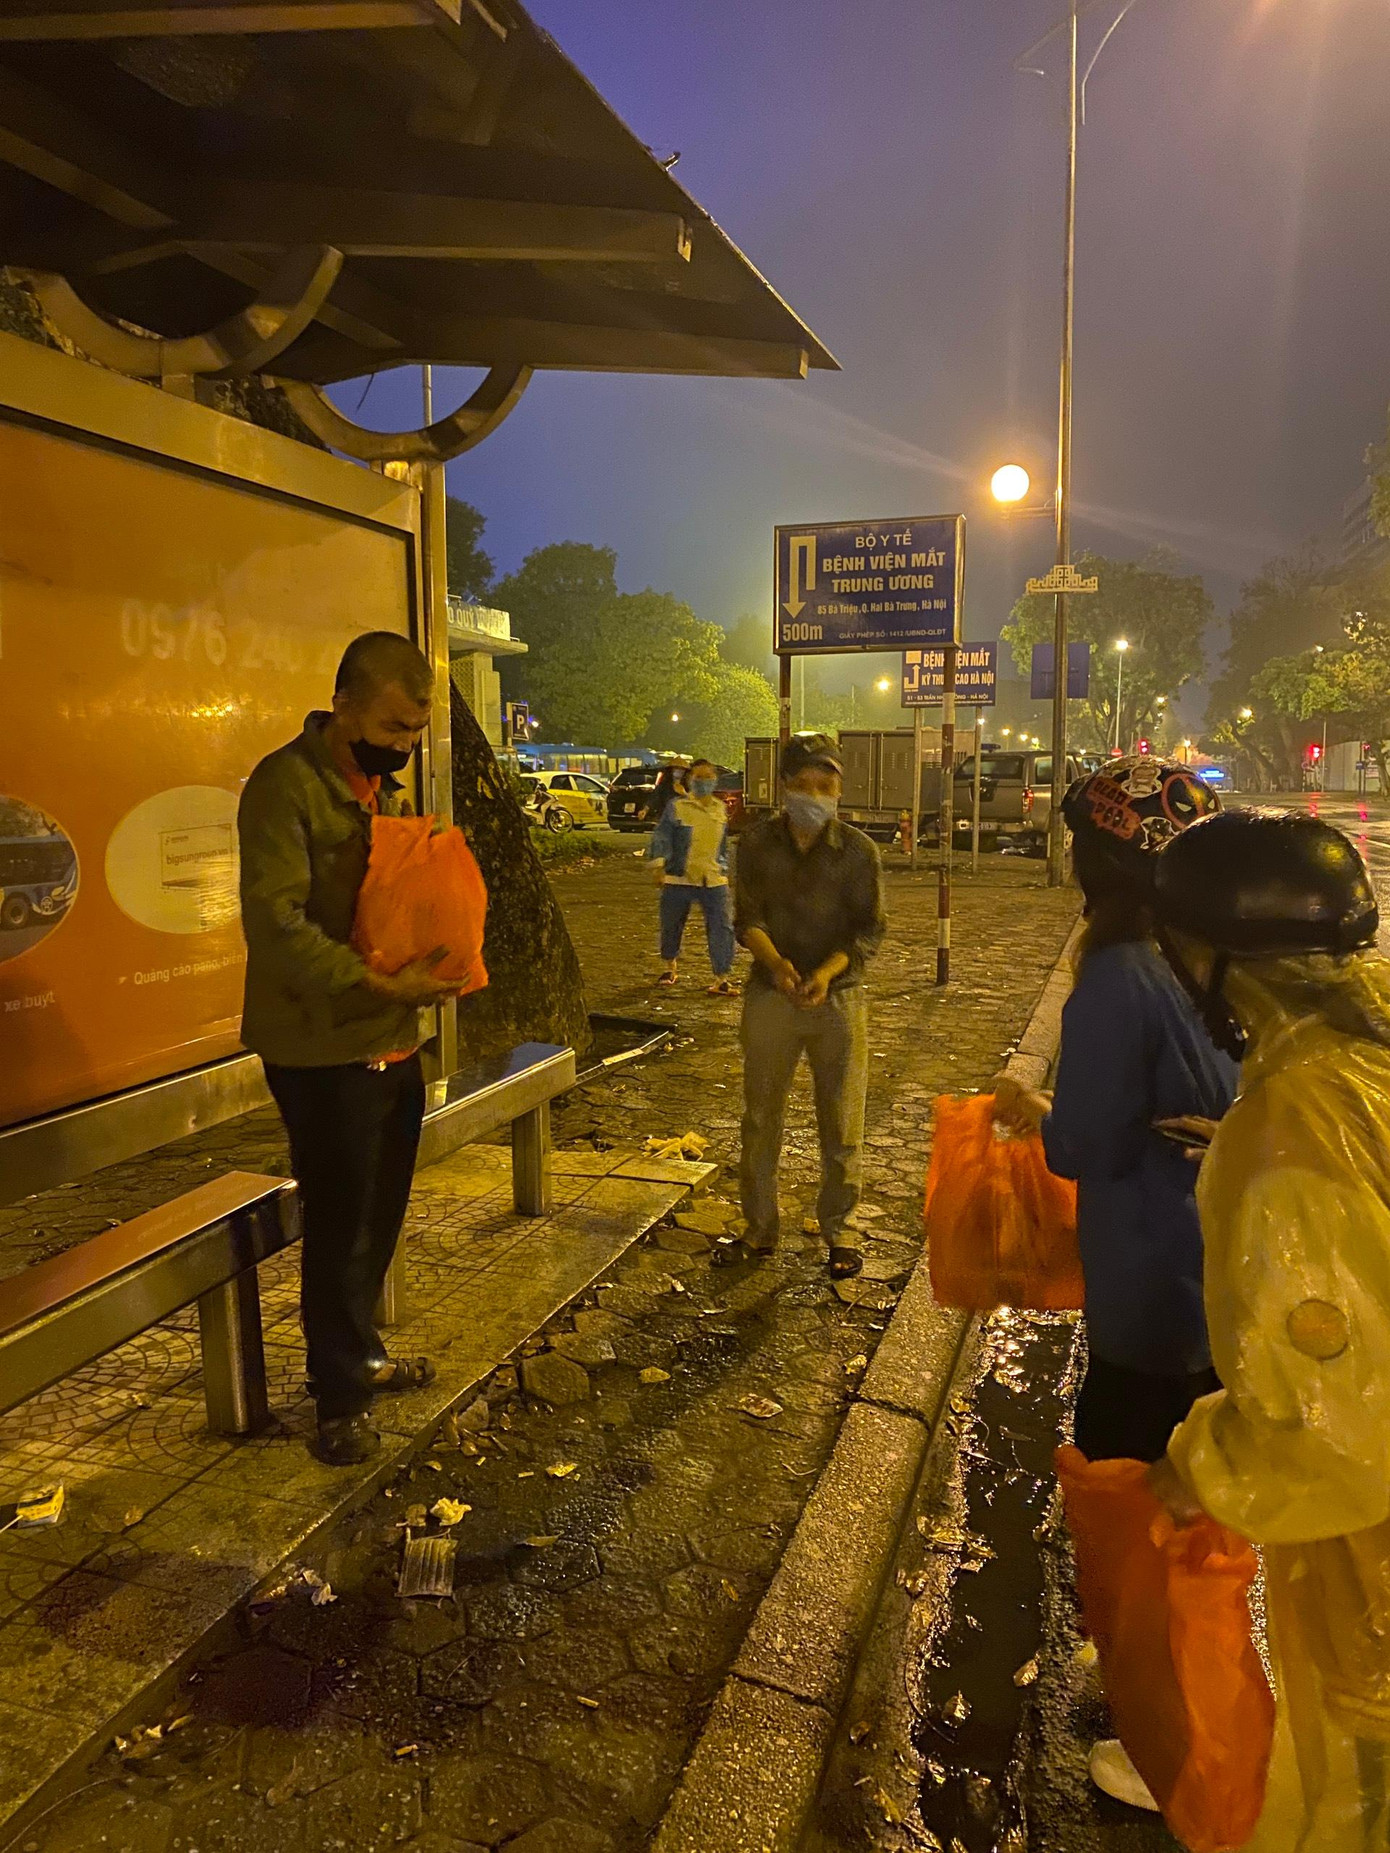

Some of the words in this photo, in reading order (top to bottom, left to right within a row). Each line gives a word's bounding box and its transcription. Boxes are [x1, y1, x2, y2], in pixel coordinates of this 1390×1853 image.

[855, 533, 876, 551] BỘ
[880, 535, 890, 547] Y
[894, 528, 912, 546] TẾ
[822, 555, 865, 574] BỆNH
[869, 552, 906, 571] VIỆN
[911, 547, 946, 567] MẮT
[831, 579, 884, 593] TRUNG
[888, 574, 934, 591] ƯƠNG
[921, 599, 932, 610] Hà
[782, 622, 823, 642] 500m
[970, 647, 990, 667] MẮT
[954, 672, 969, 685] CAO
[970, 670, 980, 685] HÀ
[981, 670, 994, 687] NỘI
[516, 714, 525, 730] P
[4, 1000, 21, 1012] xe
